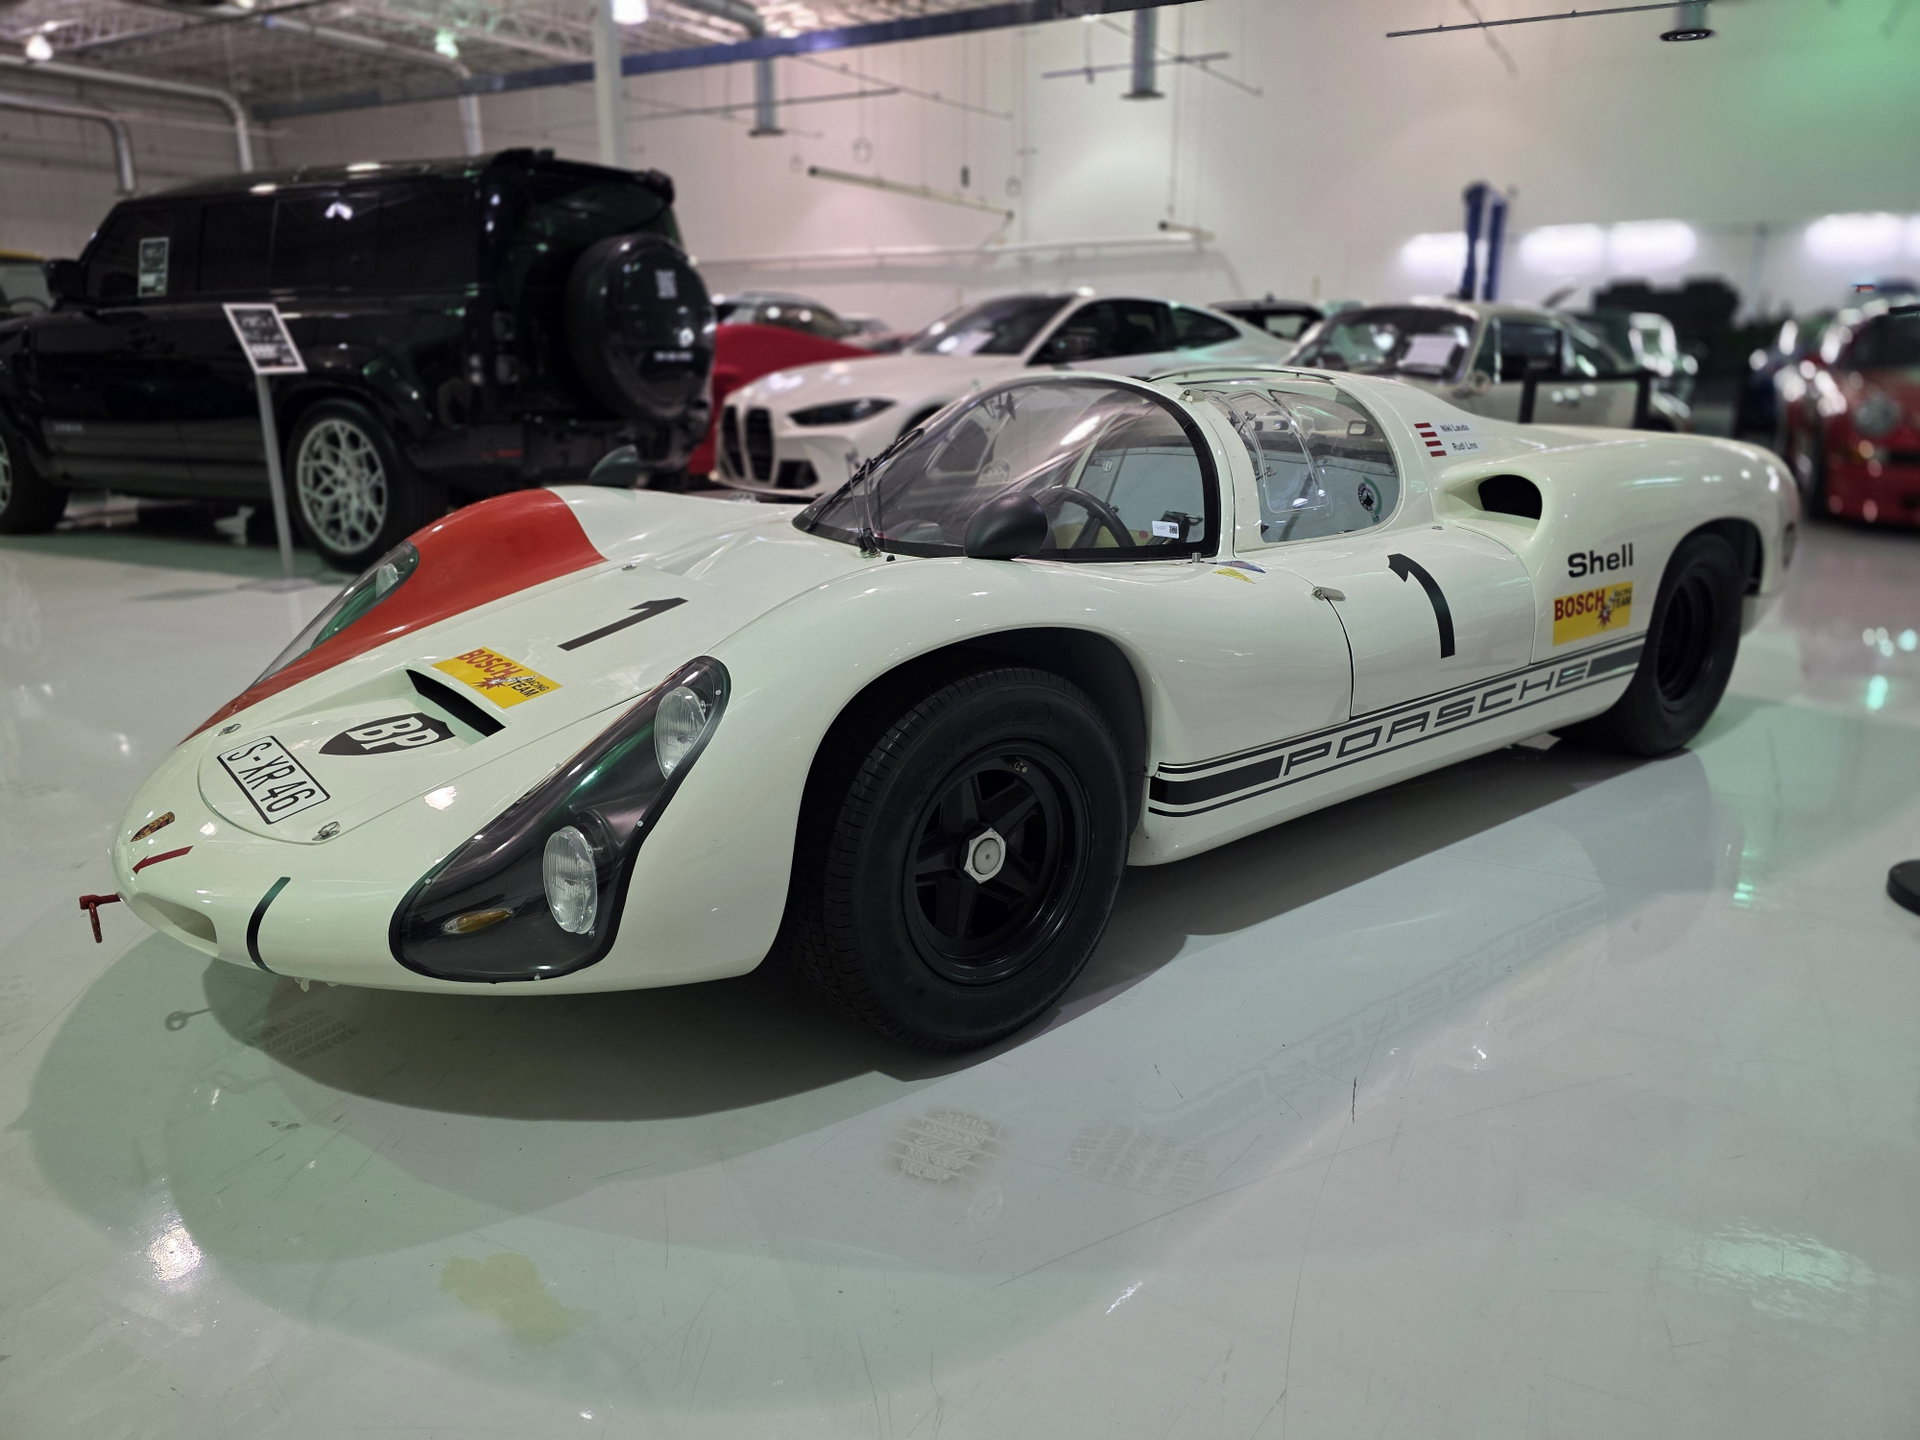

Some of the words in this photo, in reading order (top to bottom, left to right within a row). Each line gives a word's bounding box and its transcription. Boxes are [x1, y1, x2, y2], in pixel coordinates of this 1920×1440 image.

[1567, 542, 1633, 578] Shell
[1387, 553, 1455, 659] 1
[1554, 588, 1606, 621] BOSCH
[557, 597, 688, 651] 1
[456, 648, 523, 678] BOSCH
[507, 678, 540, 698] TEAM
[345, 716, 440, 751] BP
[1283, 661, 1588, 776] PORSCHE
